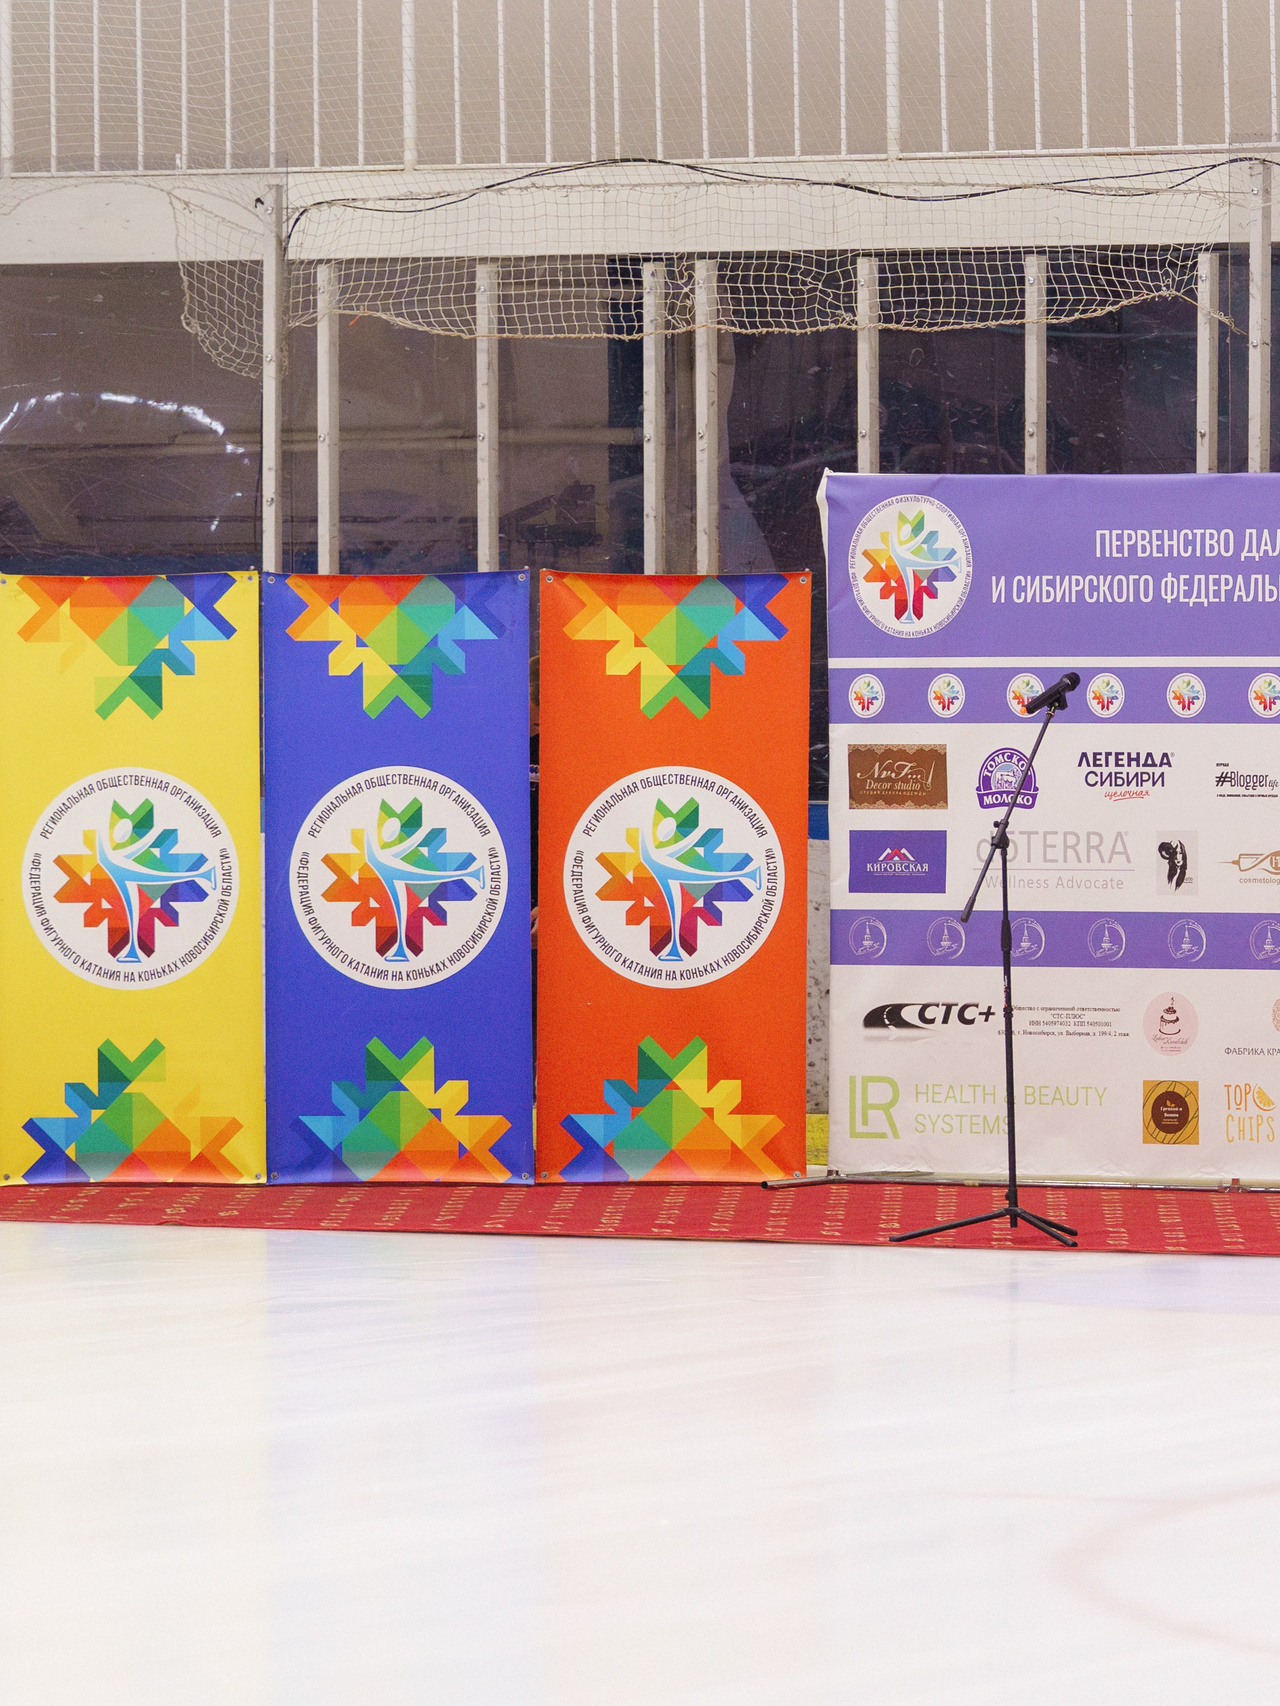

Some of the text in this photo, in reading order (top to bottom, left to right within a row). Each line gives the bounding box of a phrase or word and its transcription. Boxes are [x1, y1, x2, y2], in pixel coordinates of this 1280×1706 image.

[1095, 529, 1234, 558] ПЕРВЕНСТВО
[991, 576, 1006, 604] И
[1012, 575, 1154, 603] СИБИРСКОГО
[1078, 752, 1172, 767] ЛЕГЕНДА
[866, 779, 921, 791] Decor studio
[1085, 771, 1164, 787] СИБИРИ
[1215, 771, 1268, 790] #Blogger
[40, 775, 222, 840] РЕГИОНАЛЬНАЯ ОБЩЕСТВЕННАЯ ОРГАНИЗАЦИЯ
[308, 774, 491, 839] РЕГИОНАЛЬНАЯ ОБЩЕСТВЕННАЯ ОРГАНИЗАЦИЯ
[582, 774, 768, 838] РЕГИОНАЛЬНАЯ ОБЩЕСТВЕННАЯ ОРГАНИЗАЦИЯ
[1104, 790, 1150, 798] щелочная
[867, 863, 929, 871] КИРОВСКАЯ
[1056, 876, 1124, 889] Advocate
[297, 847, 502, 982] «ФЕДЕРАЦИЯ ФИГУРНОГО КАТАНИЯ НА КОНЬКАХ НОВОСИБИРСКОЙ ОБЛАСТИ»
[571, 848, 778, 981] «ФЕДЕРАЦИЯ ФИГУРНОГО КАТАНИЯ НА КОНЬКАХ НОВОСИБИРСКОЙ ОБЛАСТИ»
[40, 917, 80, 965] ФИГУРНОГО
[79, 959, 121, 982] КАТАНИЯ
[124, 970, 136, 982] НА
[138, 961, 180, 982] КОНЬКАХ
[180, 900, 230, 967] НОВОСИБИРСКОЙ
[1224, 1047, 1265, 1056] ФАБРИКА
[849, 1075, 901, 1140] LR
[914, 1083, 1107, 1106] HEALTH BEAUTY
[1224, 1083, 1251, 1112] TOP
[1225, 1114, 1275, 1143] CHIPS
